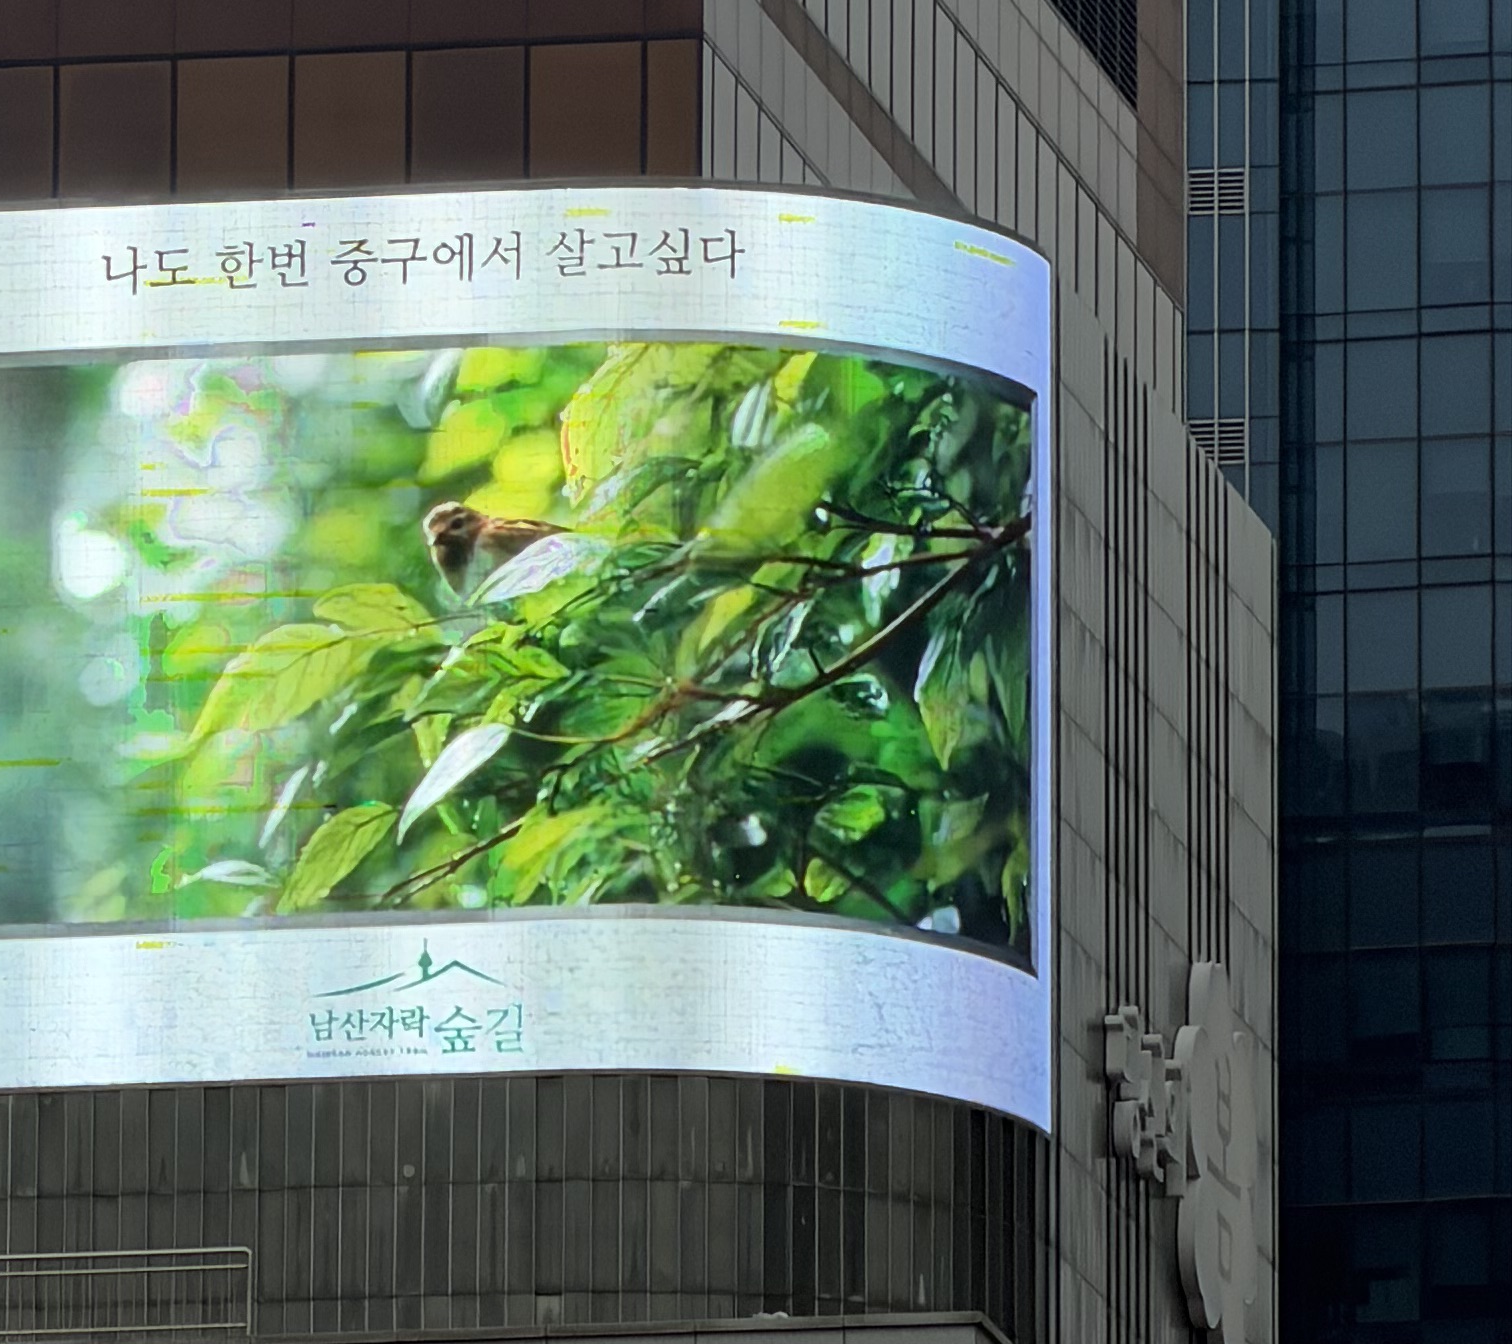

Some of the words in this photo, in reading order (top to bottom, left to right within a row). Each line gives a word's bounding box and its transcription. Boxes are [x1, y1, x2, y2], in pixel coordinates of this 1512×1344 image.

[101, 244, 197, 296] 나도
[216, 239, 310, 289] 한번
[329, 229, 523, 287] 중구에서
[544, 226, 747, 280] 살고싶다
